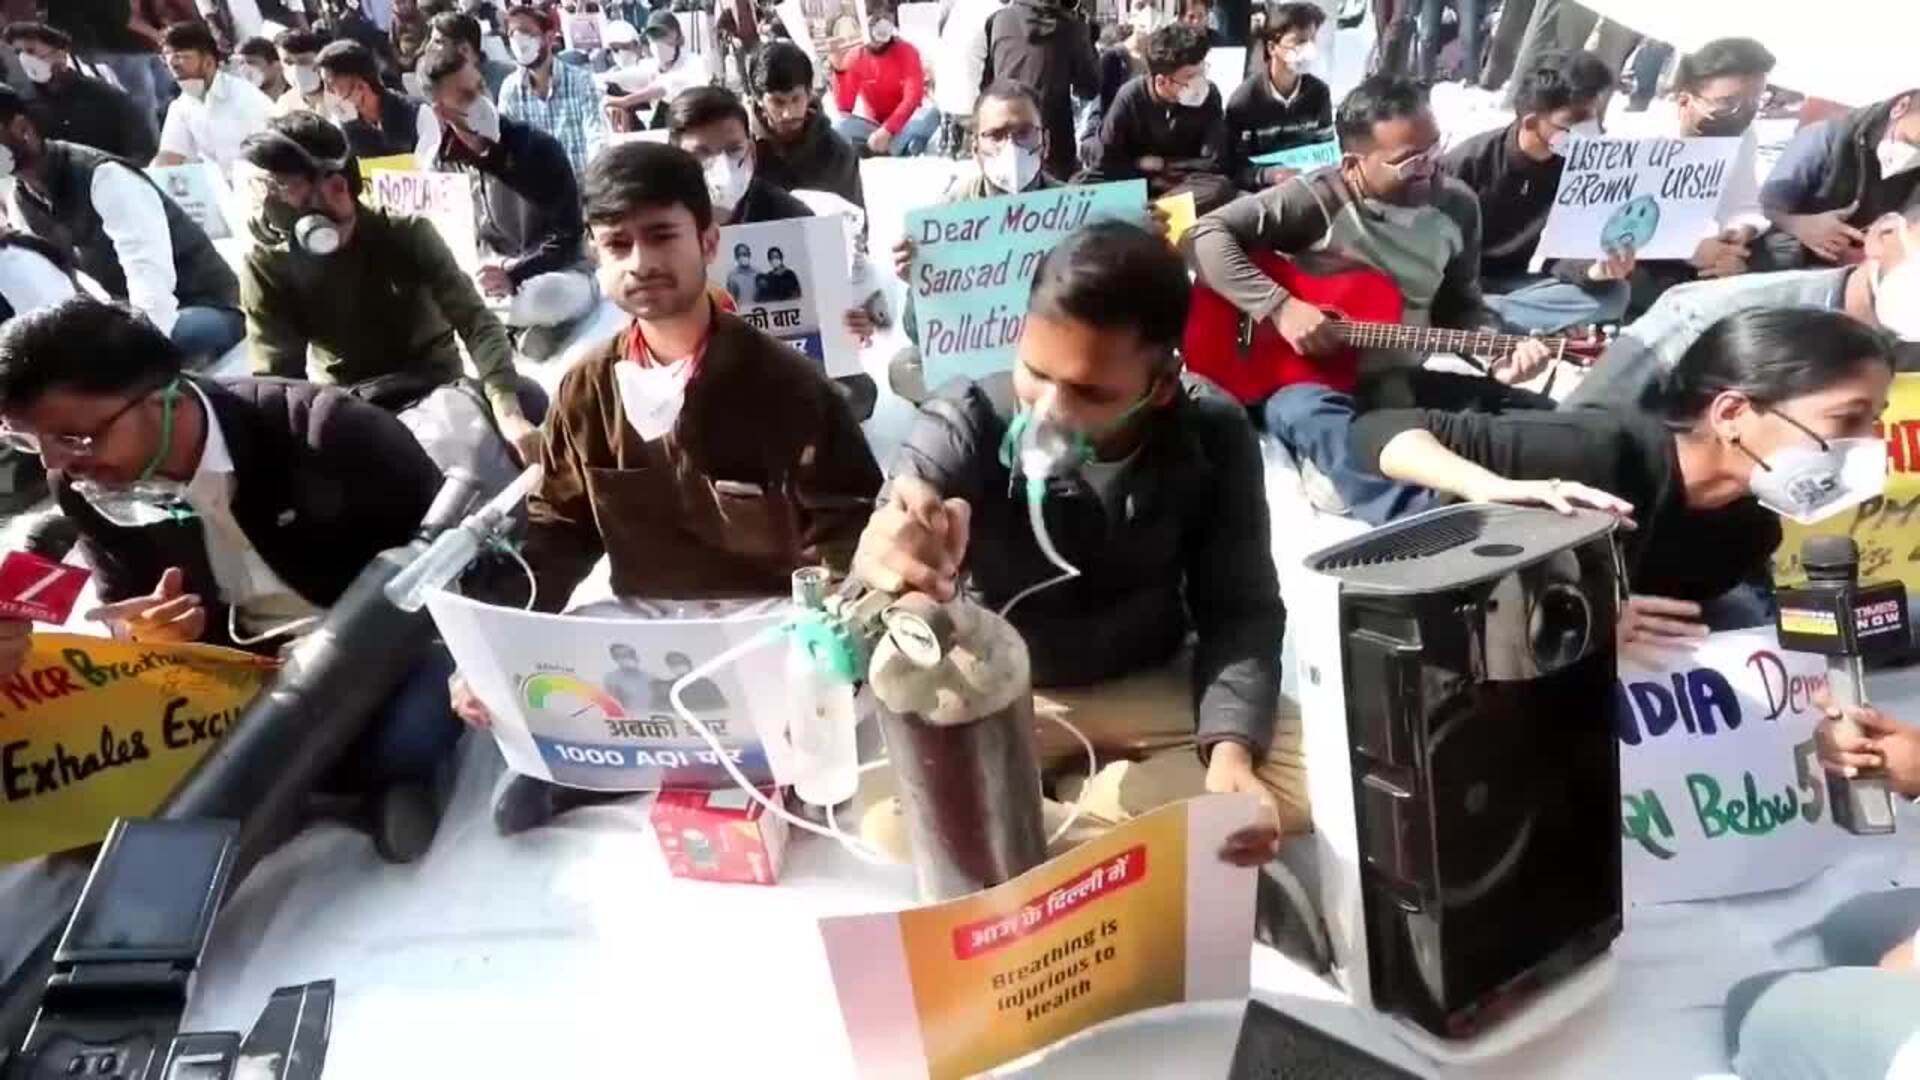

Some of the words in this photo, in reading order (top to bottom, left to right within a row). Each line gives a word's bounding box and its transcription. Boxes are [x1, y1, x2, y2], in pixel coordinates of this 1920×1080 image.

[1567, 139, 1640, 171] LISTEN
[1648, 139, 1685, 169] UP
[1558, 173, 1638, 207] GROWN
[920, 215, 990, 244] Dear
[999, 192, 1096, 234] Modiji
[919, 249, 1012, 297] Sansad
[1855, 600, 1899, 618] TIMES
[1857, 611, 1900, 630] NOW
[555, 744, 624, 766] 1000
[636, 749, 690, 768] AQI
[1020, 901, 1044, 926] के
[1046, 866, 1104, 916] दिल्ली
[1107, 854, 1130, 882] में
[991, 929, 1096, 990] Breathing
[1101, 917, 1118, 937] is
[1095, 945, 1116, 964] to
[1025, 979, 1092, 1021] Health
